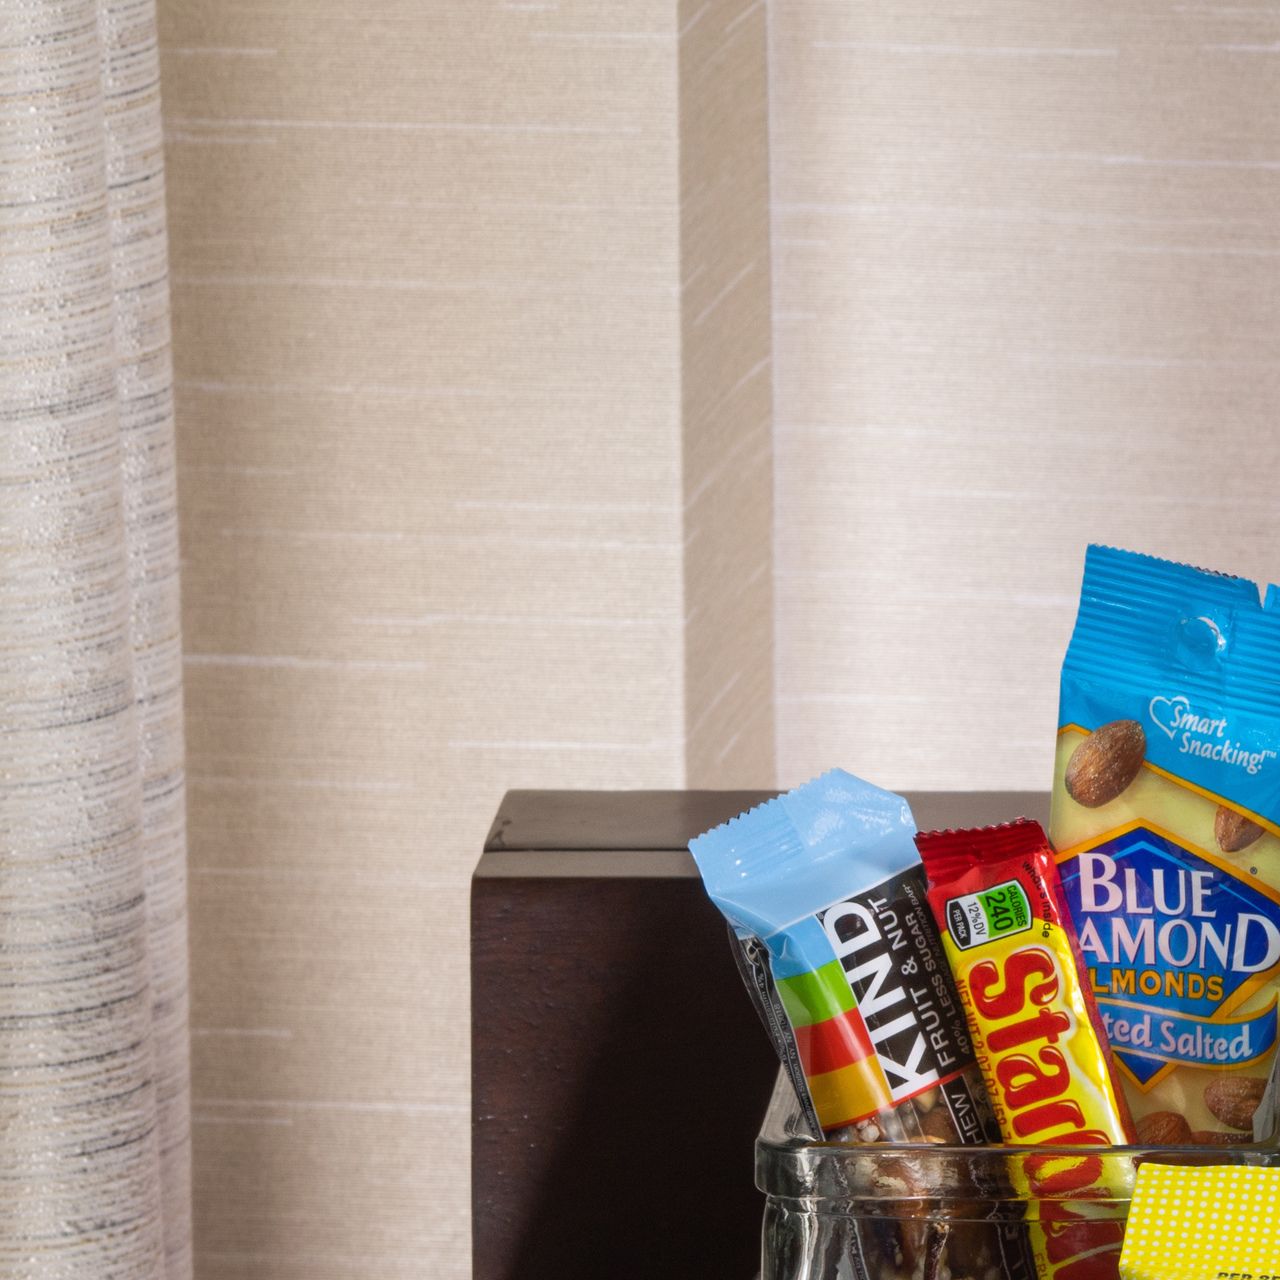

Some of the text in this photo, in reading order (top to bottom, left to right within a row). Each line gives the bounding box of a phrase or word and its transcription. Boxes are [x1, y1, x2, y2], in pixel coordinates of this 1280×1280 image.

[1170, 705, 1228, 739] Smart
[1179, 732, 1267, 775] Snacking!
[1006, 885, 1028, 928] CALORIES
[1078, 852, 1217, 919] BLUE
[868, 897, 908, 951] NUT
[952, 909, 968, 939] PER PACK
[985, 892, 1014, 931] 240
[1041, 901, 1055, 938] inside
[905, 912, 937, 972] SUGAR
[901, 955, 919, 975] &
[1090, 968, 1224, 1002] LMONDS
[823, 900, 941, 1103] KIND
[931, 974, 957, 1017] LESS
[909, 987, 956, 1068] FRUIT
[952, 1019, 970, 1054] 40%
[1159, 1020, 1254, 1061] Salted
[952, 1094, 984, 1145] HEW
